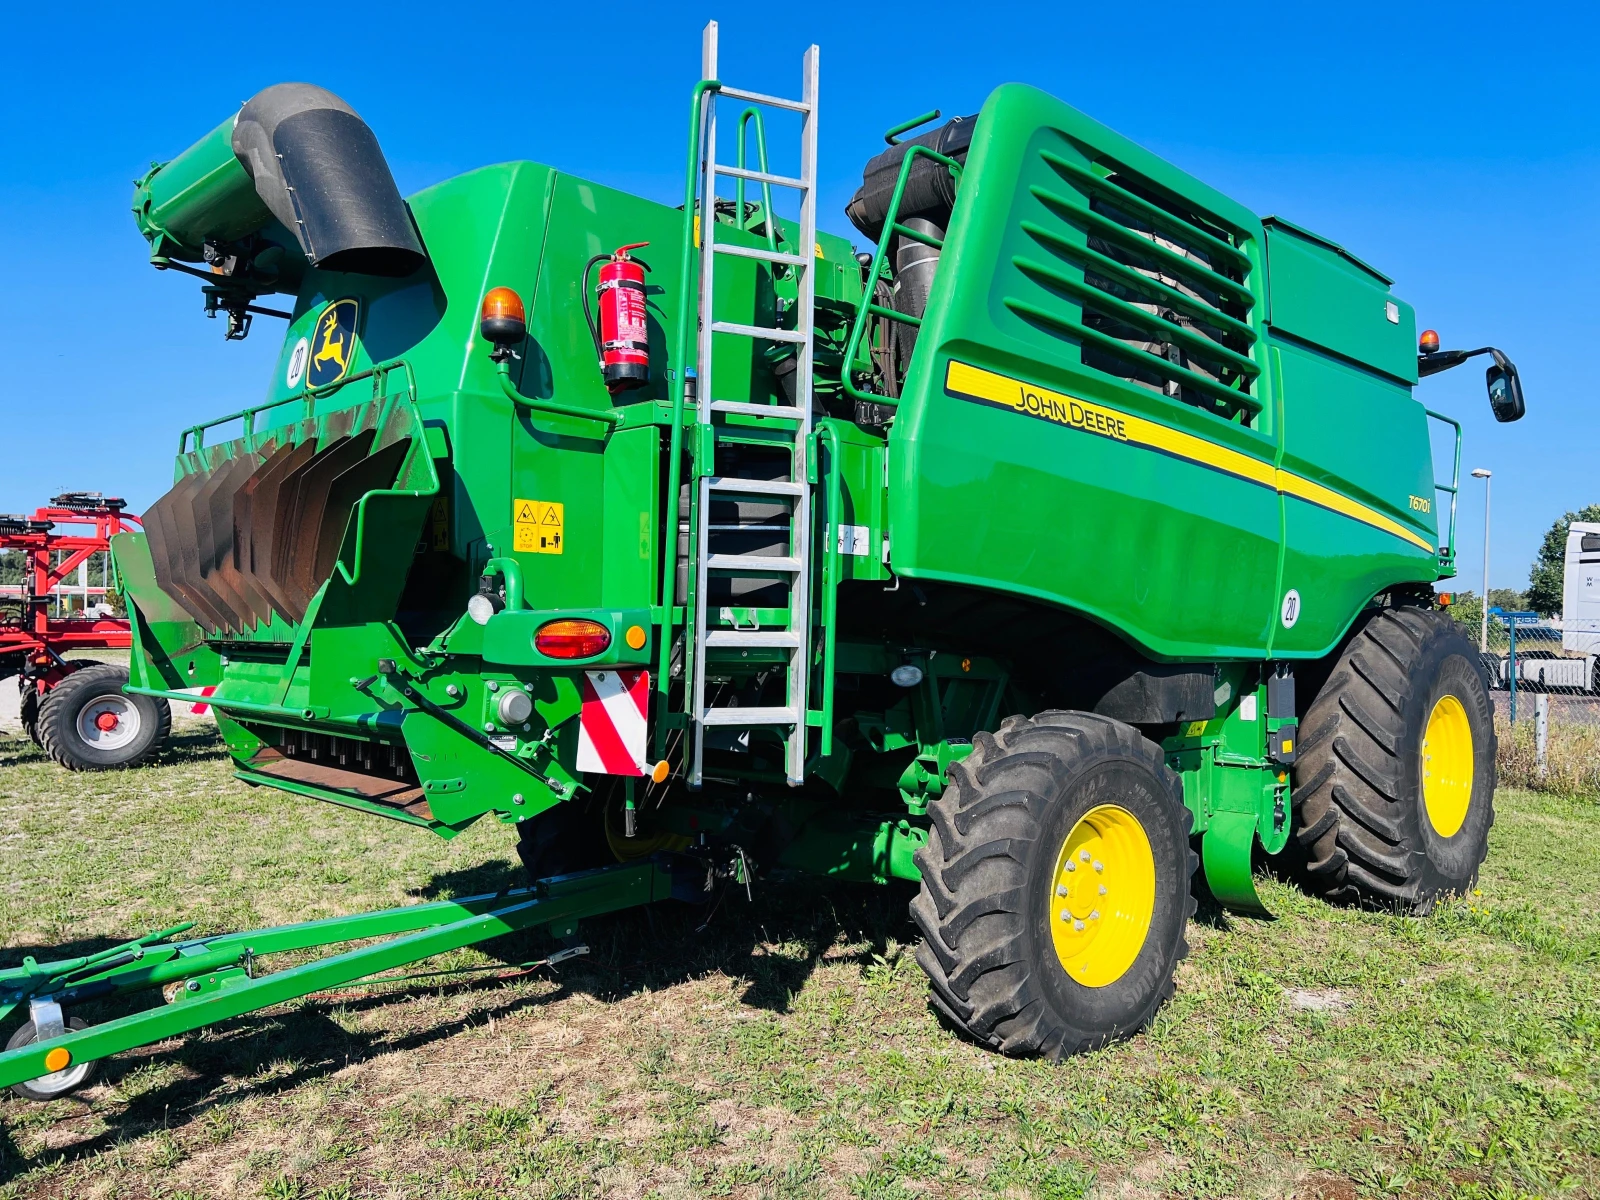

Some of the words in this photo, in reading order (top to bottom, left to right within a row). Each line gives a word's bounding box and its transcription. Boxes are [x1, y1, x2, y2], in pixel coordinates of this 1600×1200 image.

[291, 346, 304, 379] 20
[1015, 386, 1067, 421] JOHN
[1070, 402, 1127, 438] DEERE
[1408, 494, 1431, 514] T670i
[1285, 597, 1296, 621] 20
